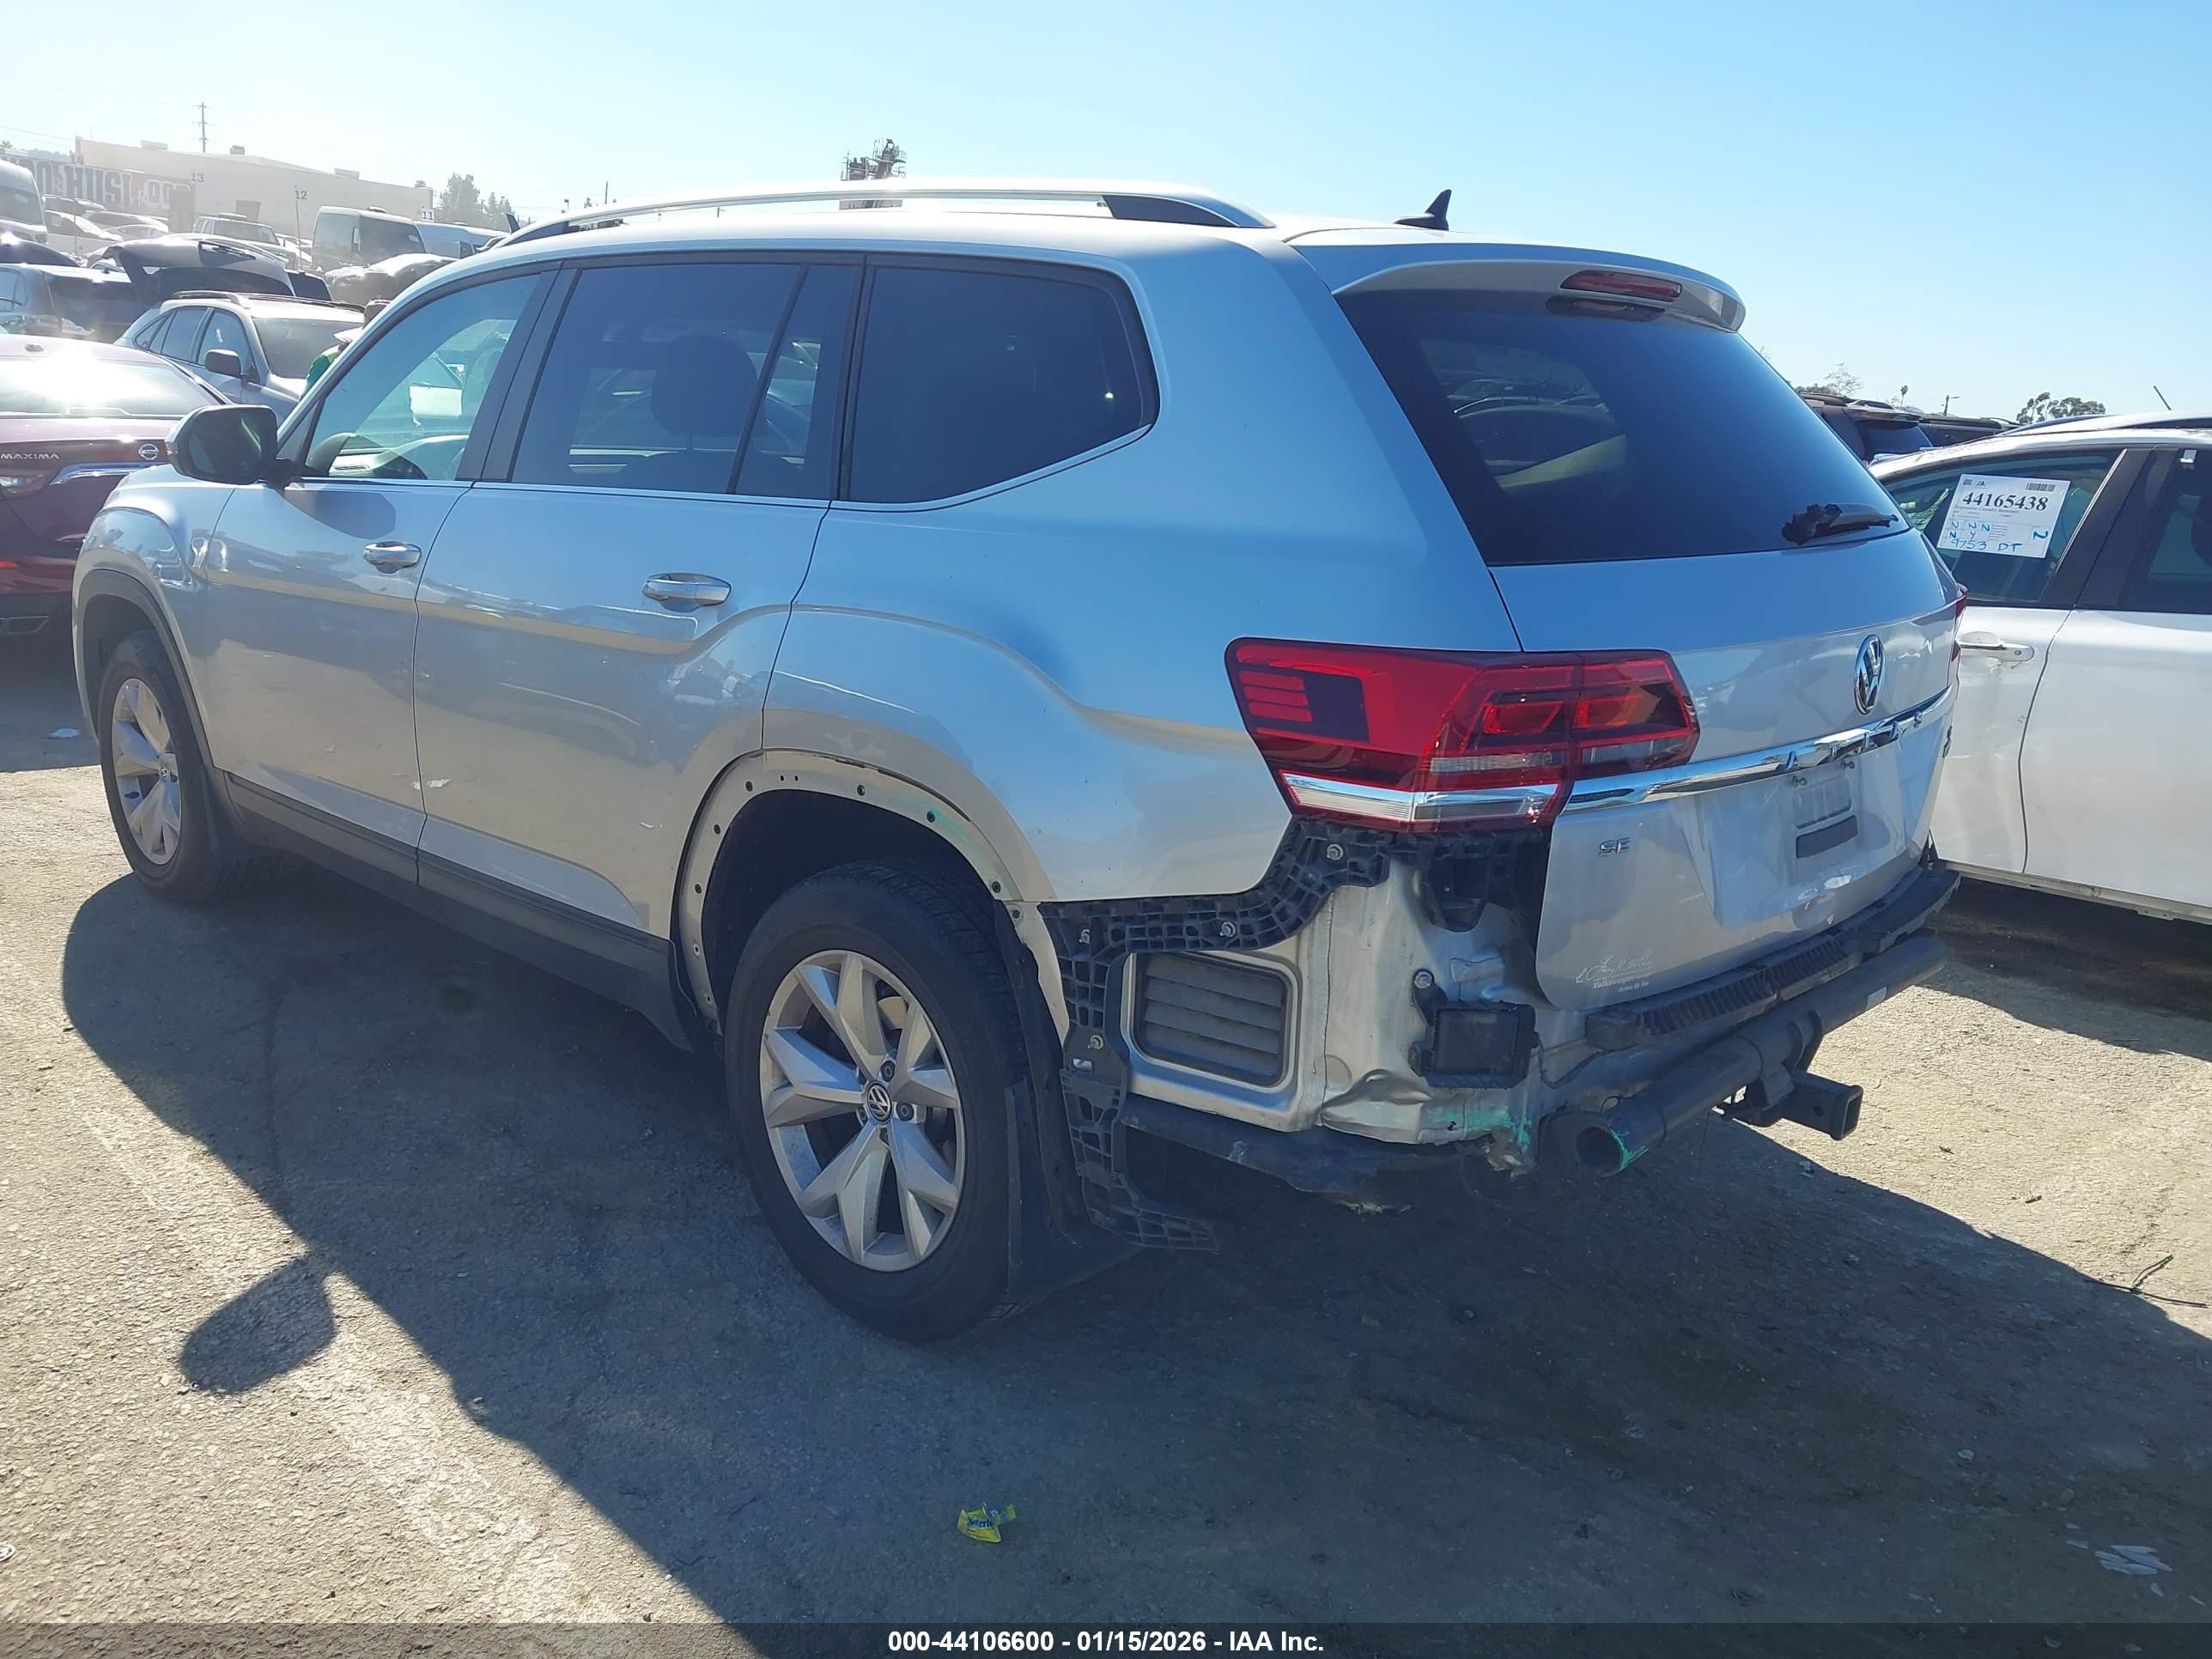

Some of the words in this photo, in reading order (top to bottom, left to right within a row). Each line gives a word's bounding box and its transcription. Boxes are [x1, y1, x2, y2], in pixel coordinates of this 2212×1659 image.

[191, 172, 205, 183] 13
[295, 190, 307, 200] 12
[1962, 491, 2049, 512] 44165438
[1951, 538, 1987, 550] 9753
[1998, 542, 2024, 553] DT
